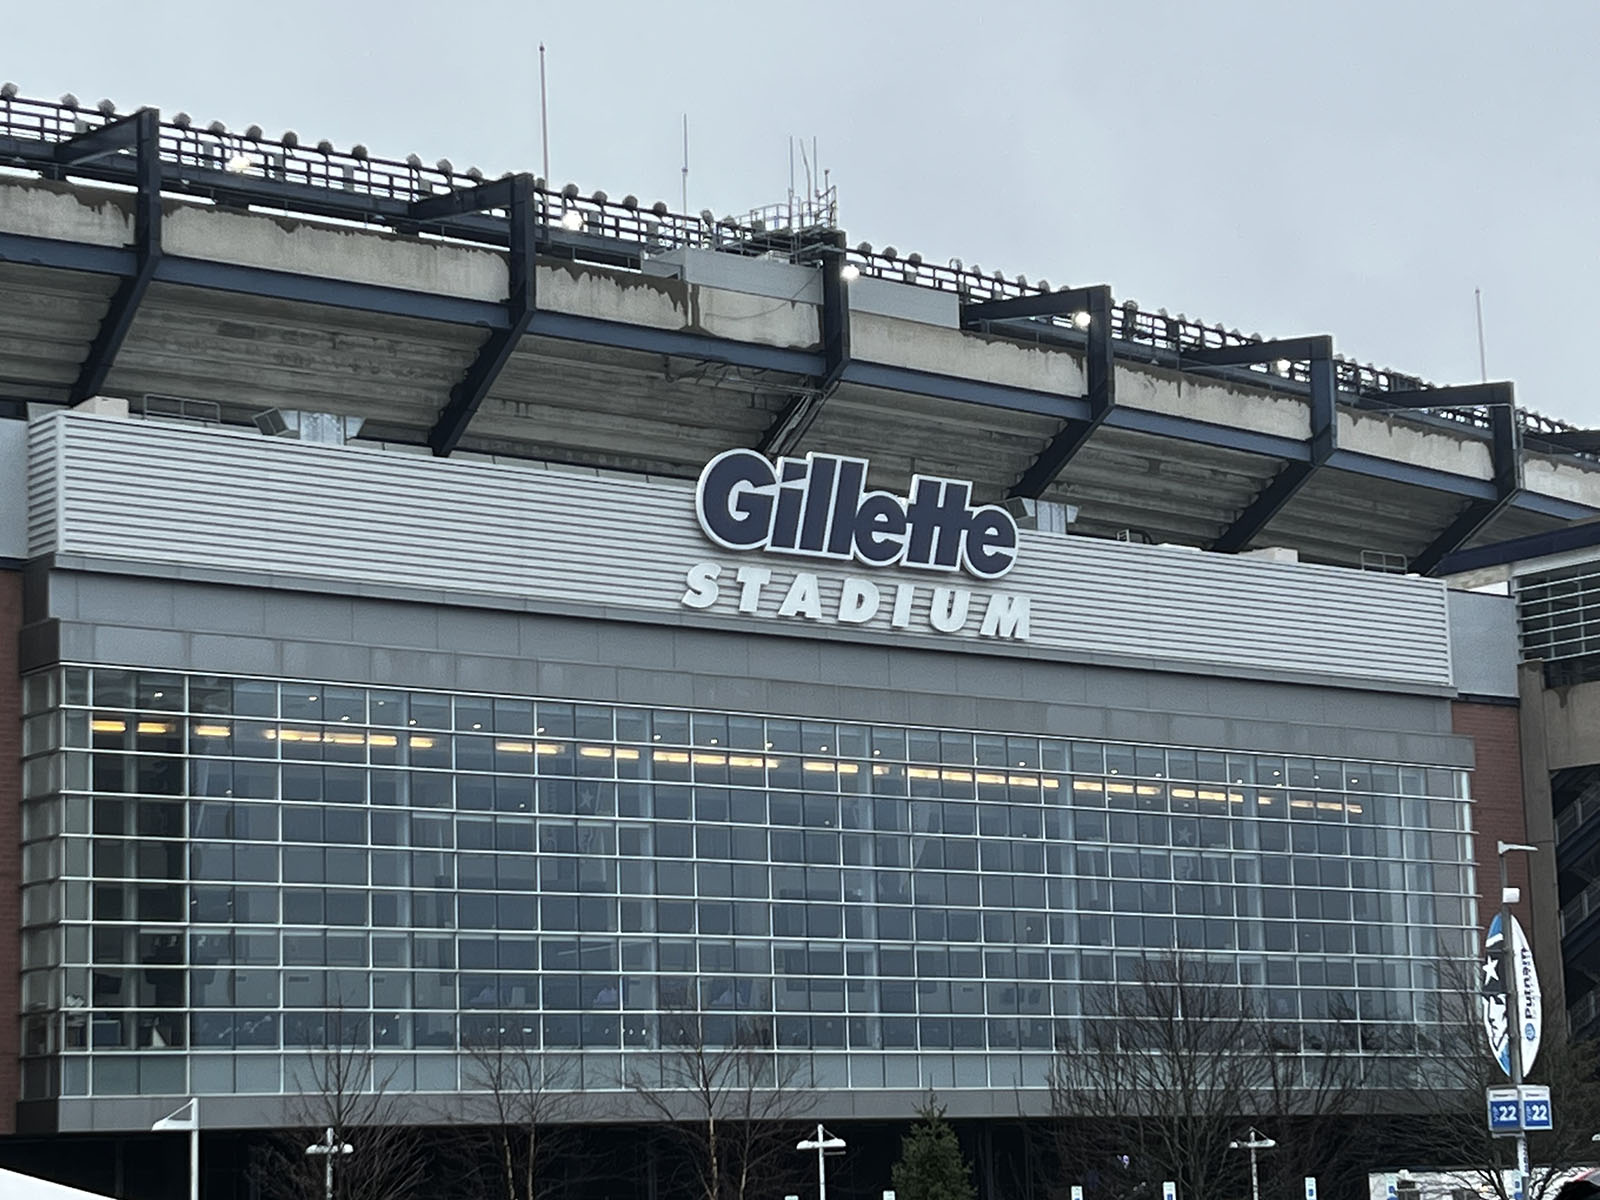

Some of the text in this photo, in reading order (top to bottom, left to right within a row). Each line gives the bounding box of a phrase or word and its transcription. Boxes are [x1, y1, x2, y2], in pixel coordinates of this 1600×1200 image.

[696, 449, 1019, 579] Gillette
[682, 563, 1031, 639] STADIUM
[1499, 1105, 1518, 1121] 22
[1531, 1104, 1548, 1121] 22
